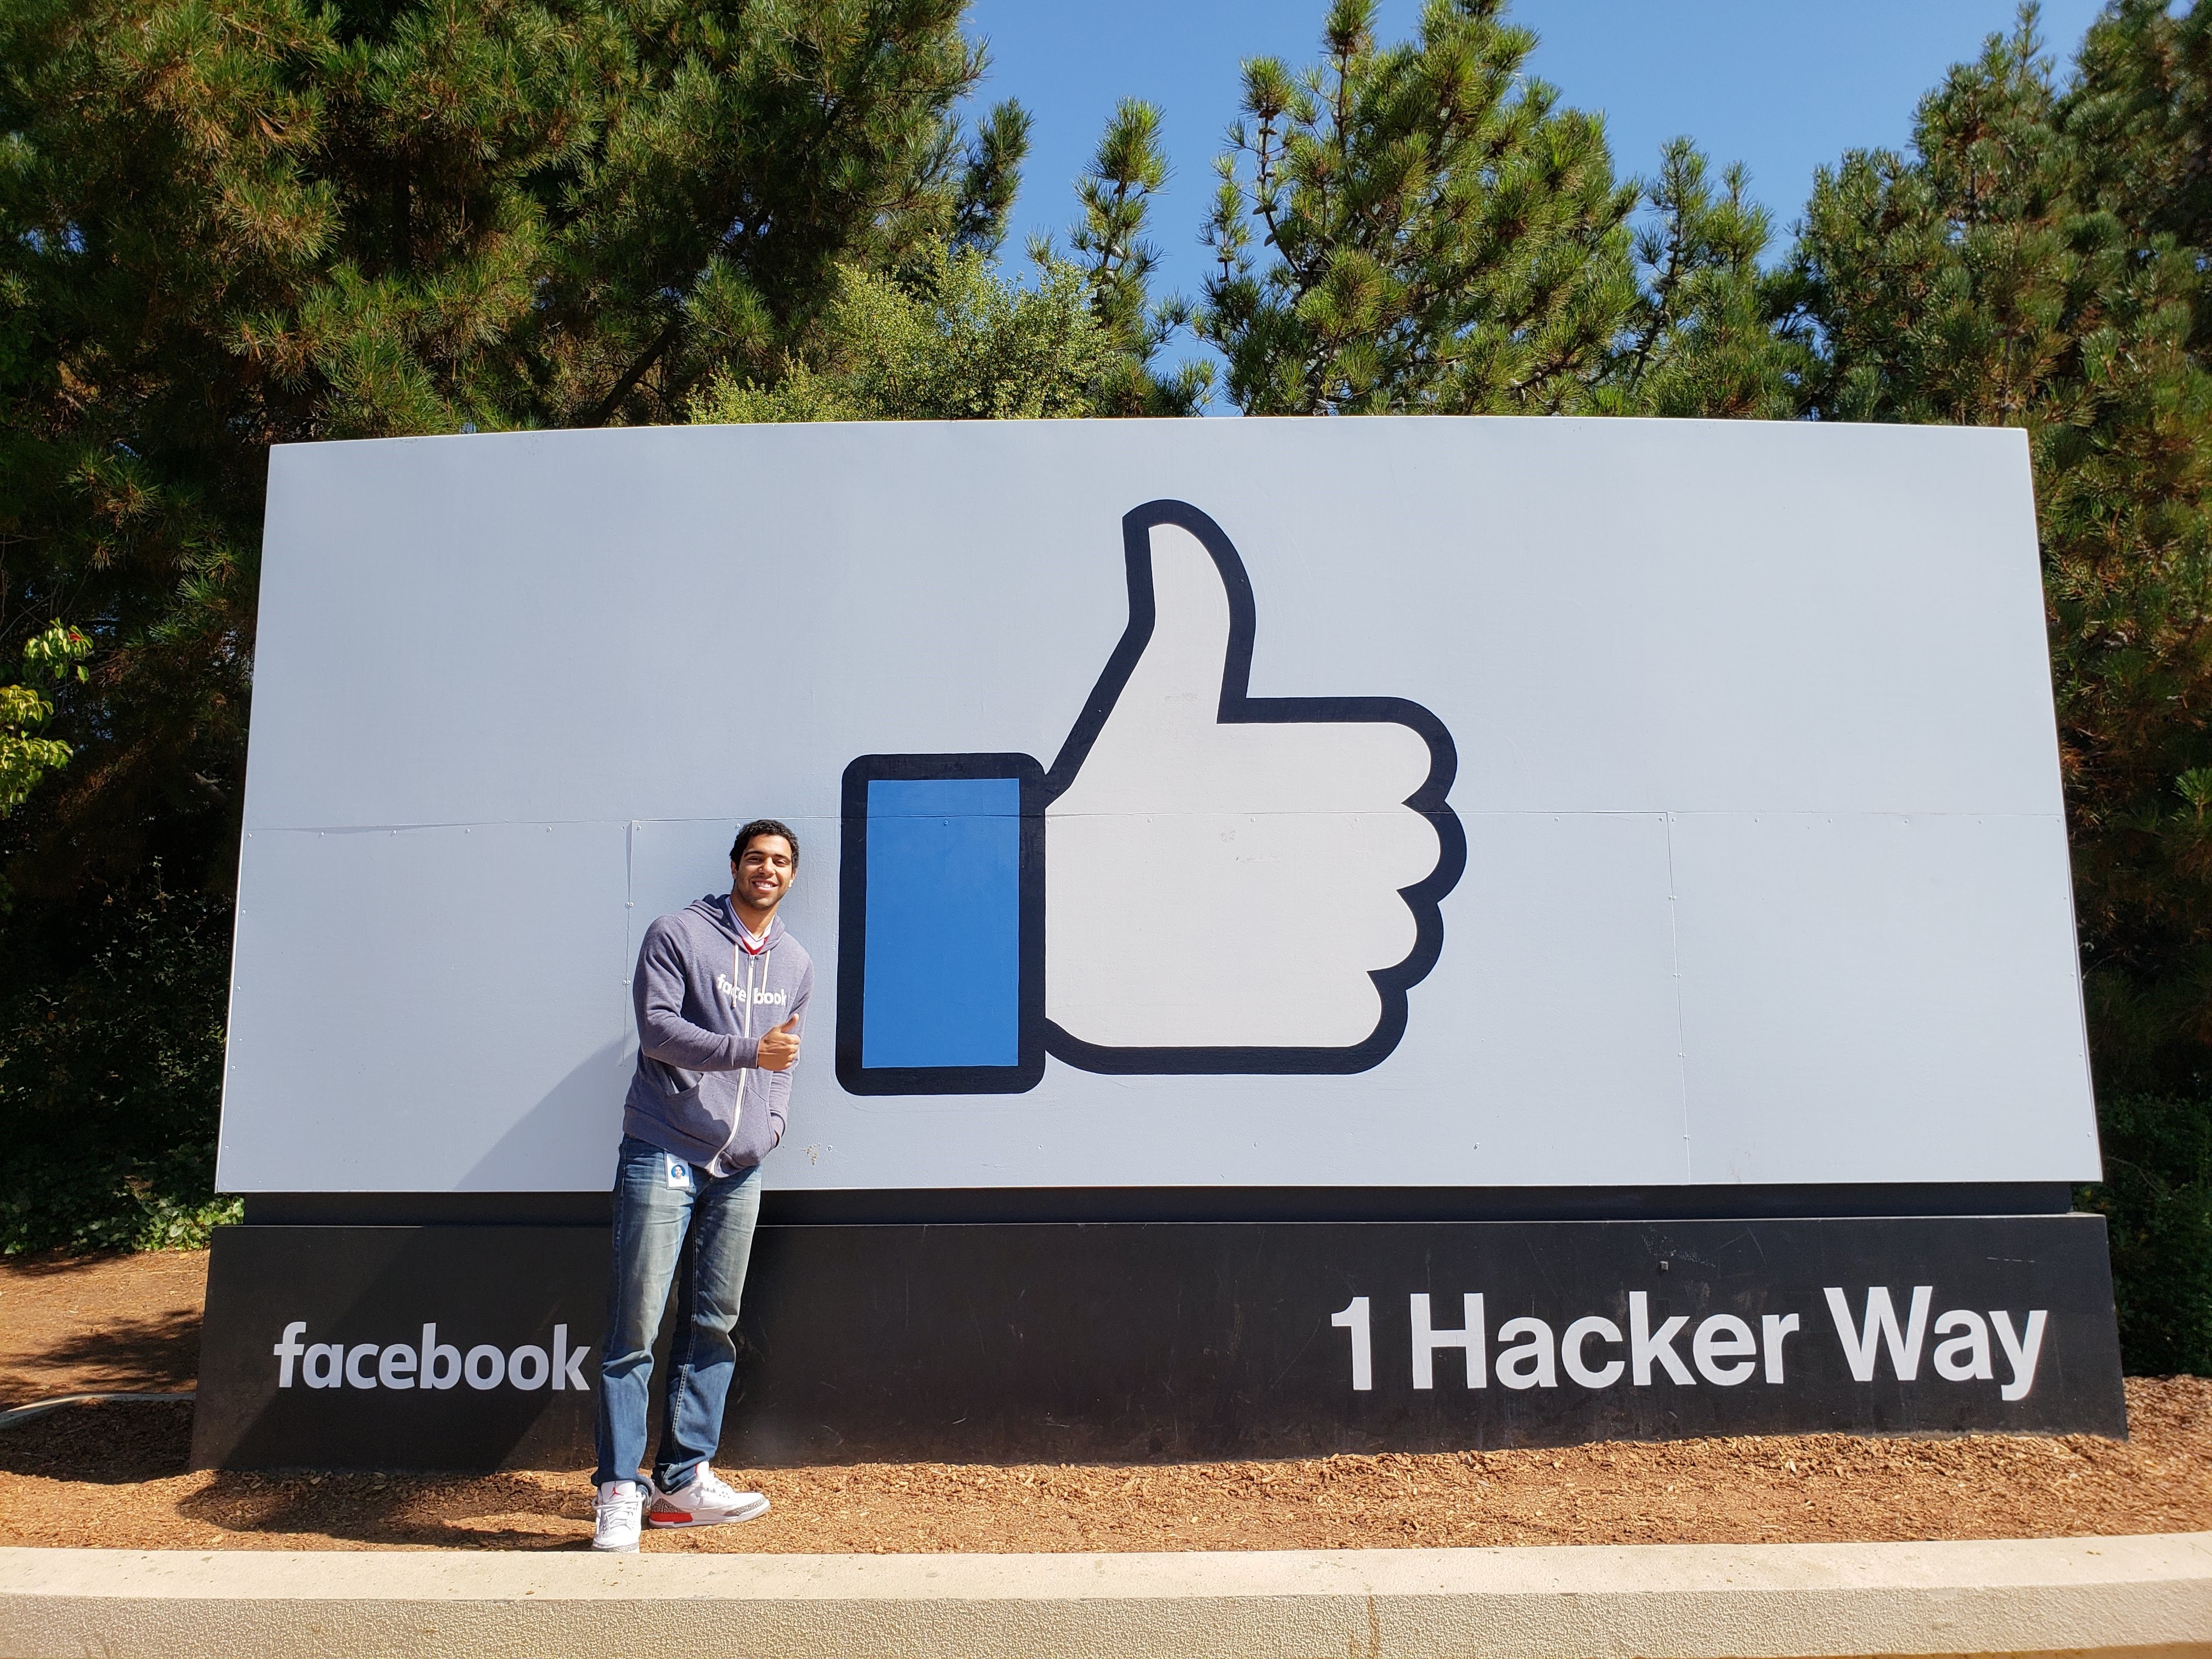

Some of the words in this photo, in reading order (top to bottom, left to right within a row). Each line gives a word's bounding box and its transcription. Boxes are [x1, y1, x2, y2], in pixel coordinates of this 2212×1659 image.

[718, 973, 787, 1007] facebook
[273, 1321, 591, 1391] facebook
[1331, 1296, 1372, 1391] 1
[1410, 1291, 1800, 1390] Hacker
[1823, 1285, 2049, 1402] Way
